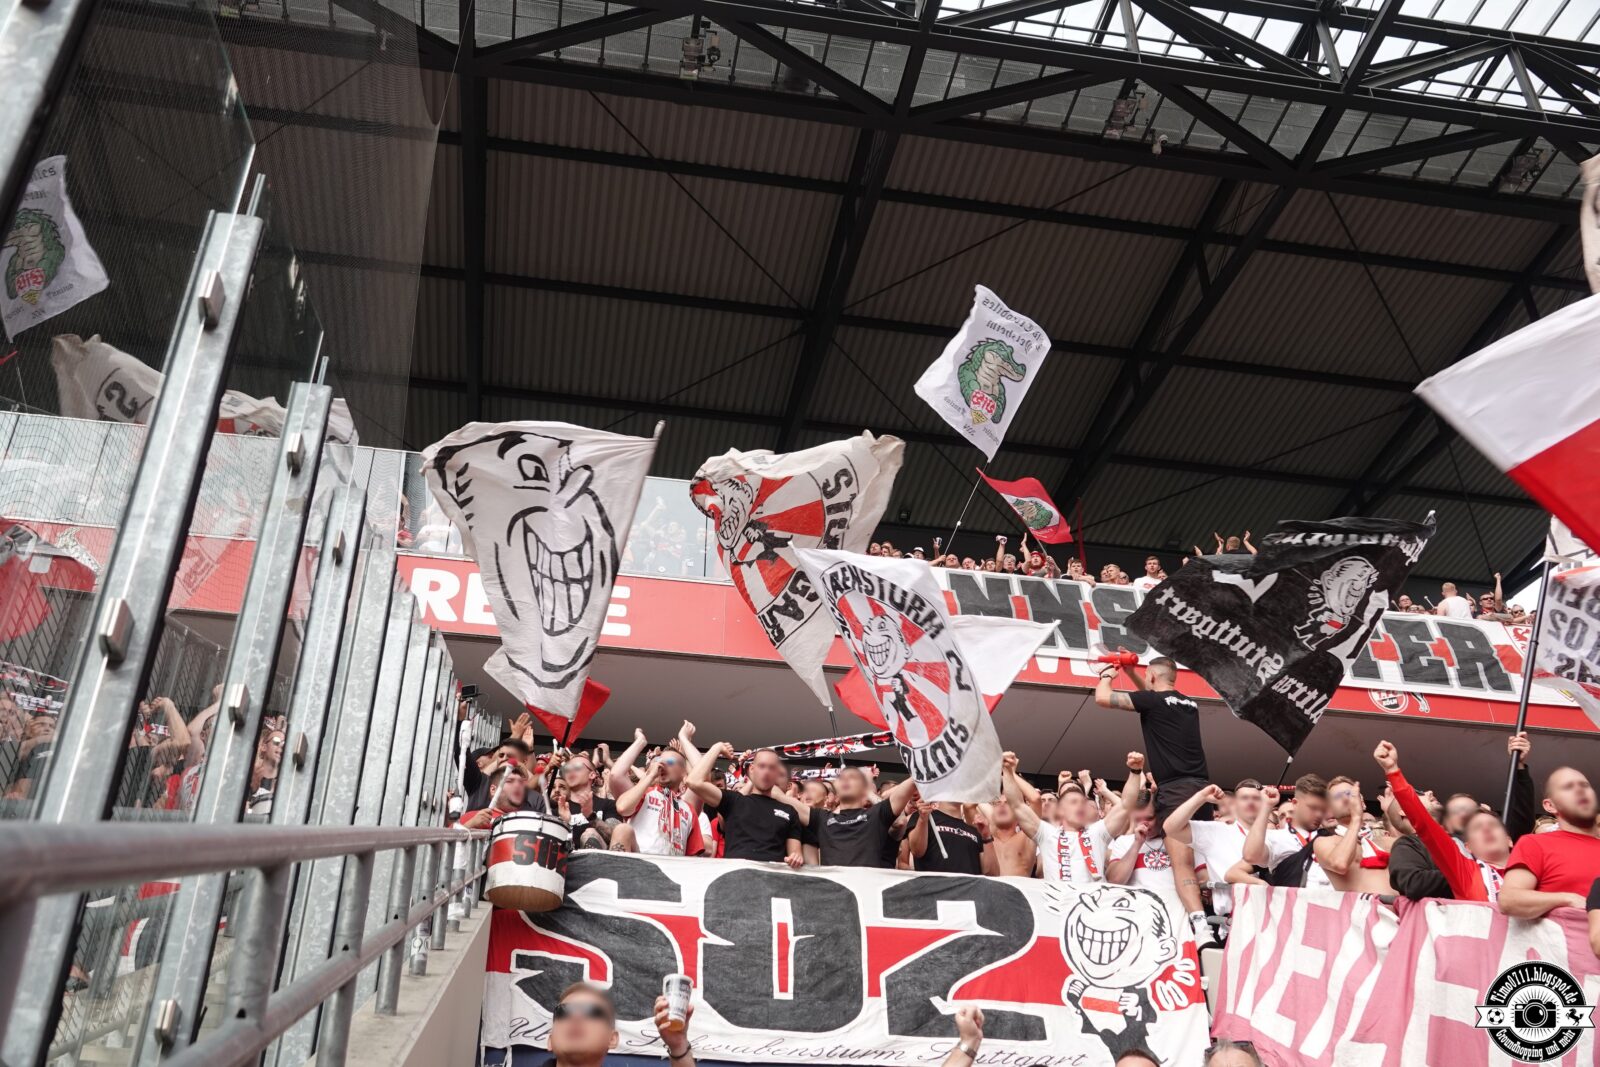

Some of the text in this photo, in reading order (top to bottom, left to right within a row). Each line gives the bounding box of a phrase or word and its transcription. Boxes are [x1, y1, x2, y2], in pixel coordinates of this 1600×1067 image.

[410, 567, 632, 638] REE
[626, 1029, 904, 1061] Shwabensturm
[918, 1041, 1090, 1067] Suttgart
